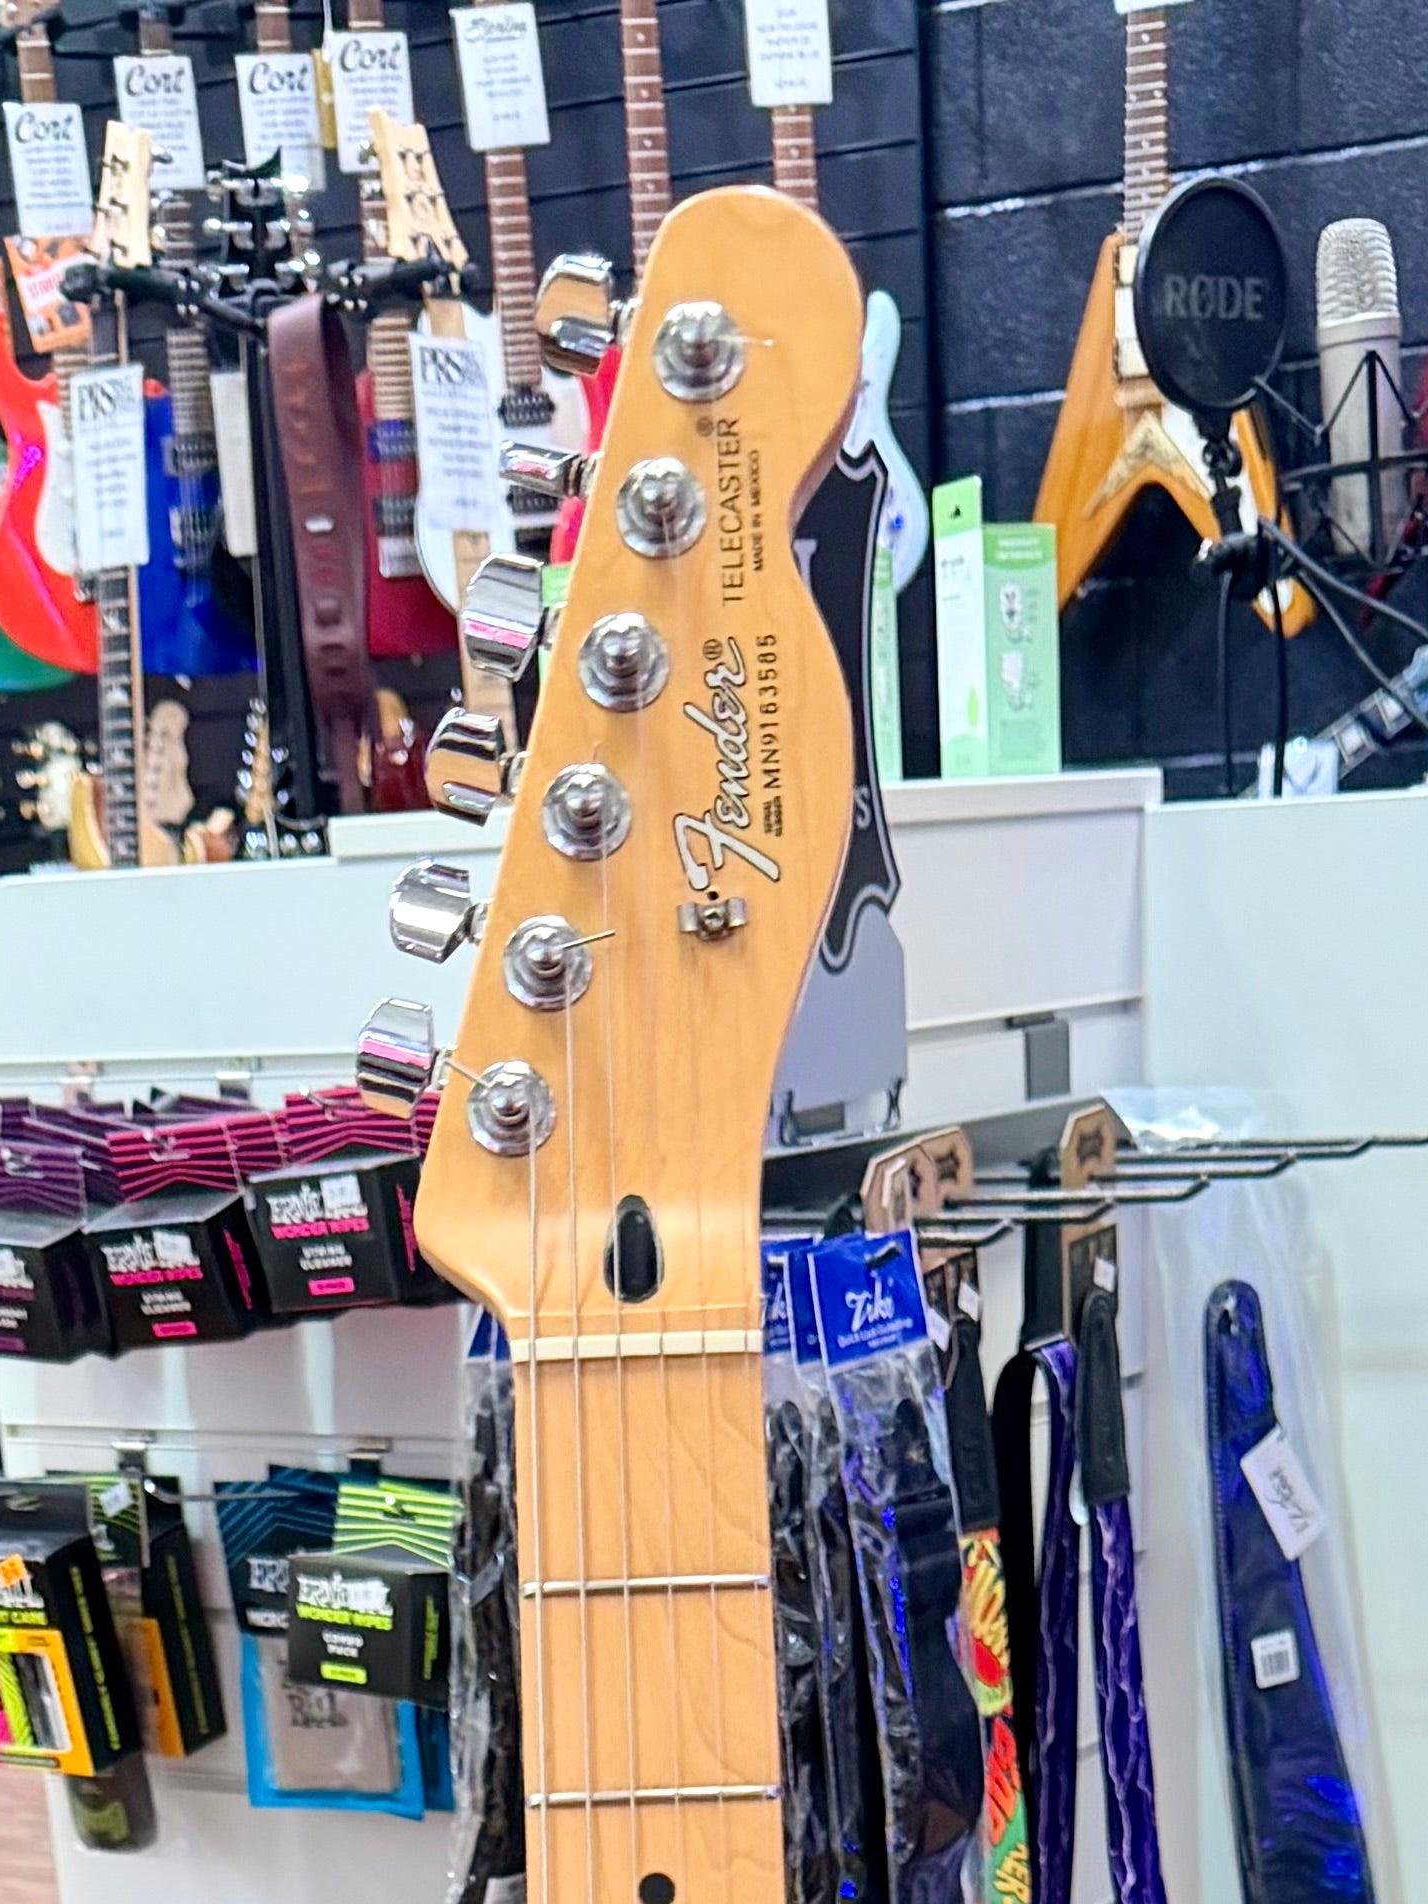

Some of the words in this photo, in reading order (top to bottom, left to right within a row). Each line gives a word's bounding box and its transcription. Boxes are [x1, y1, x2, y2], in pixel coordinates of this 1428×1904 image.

[339, 35, 401, 73] Cort
[126, 63, 184, 95] Cort
[249, 61, 310, 93] Cort
[15, 112, 73, 144] Cort
[748, 450, 761, 506] MEXICO
[717, 418, 745, 607] TELECASTER
[751, 534, 763, 572] MADE
[673, 636, 780, 891] Fender
